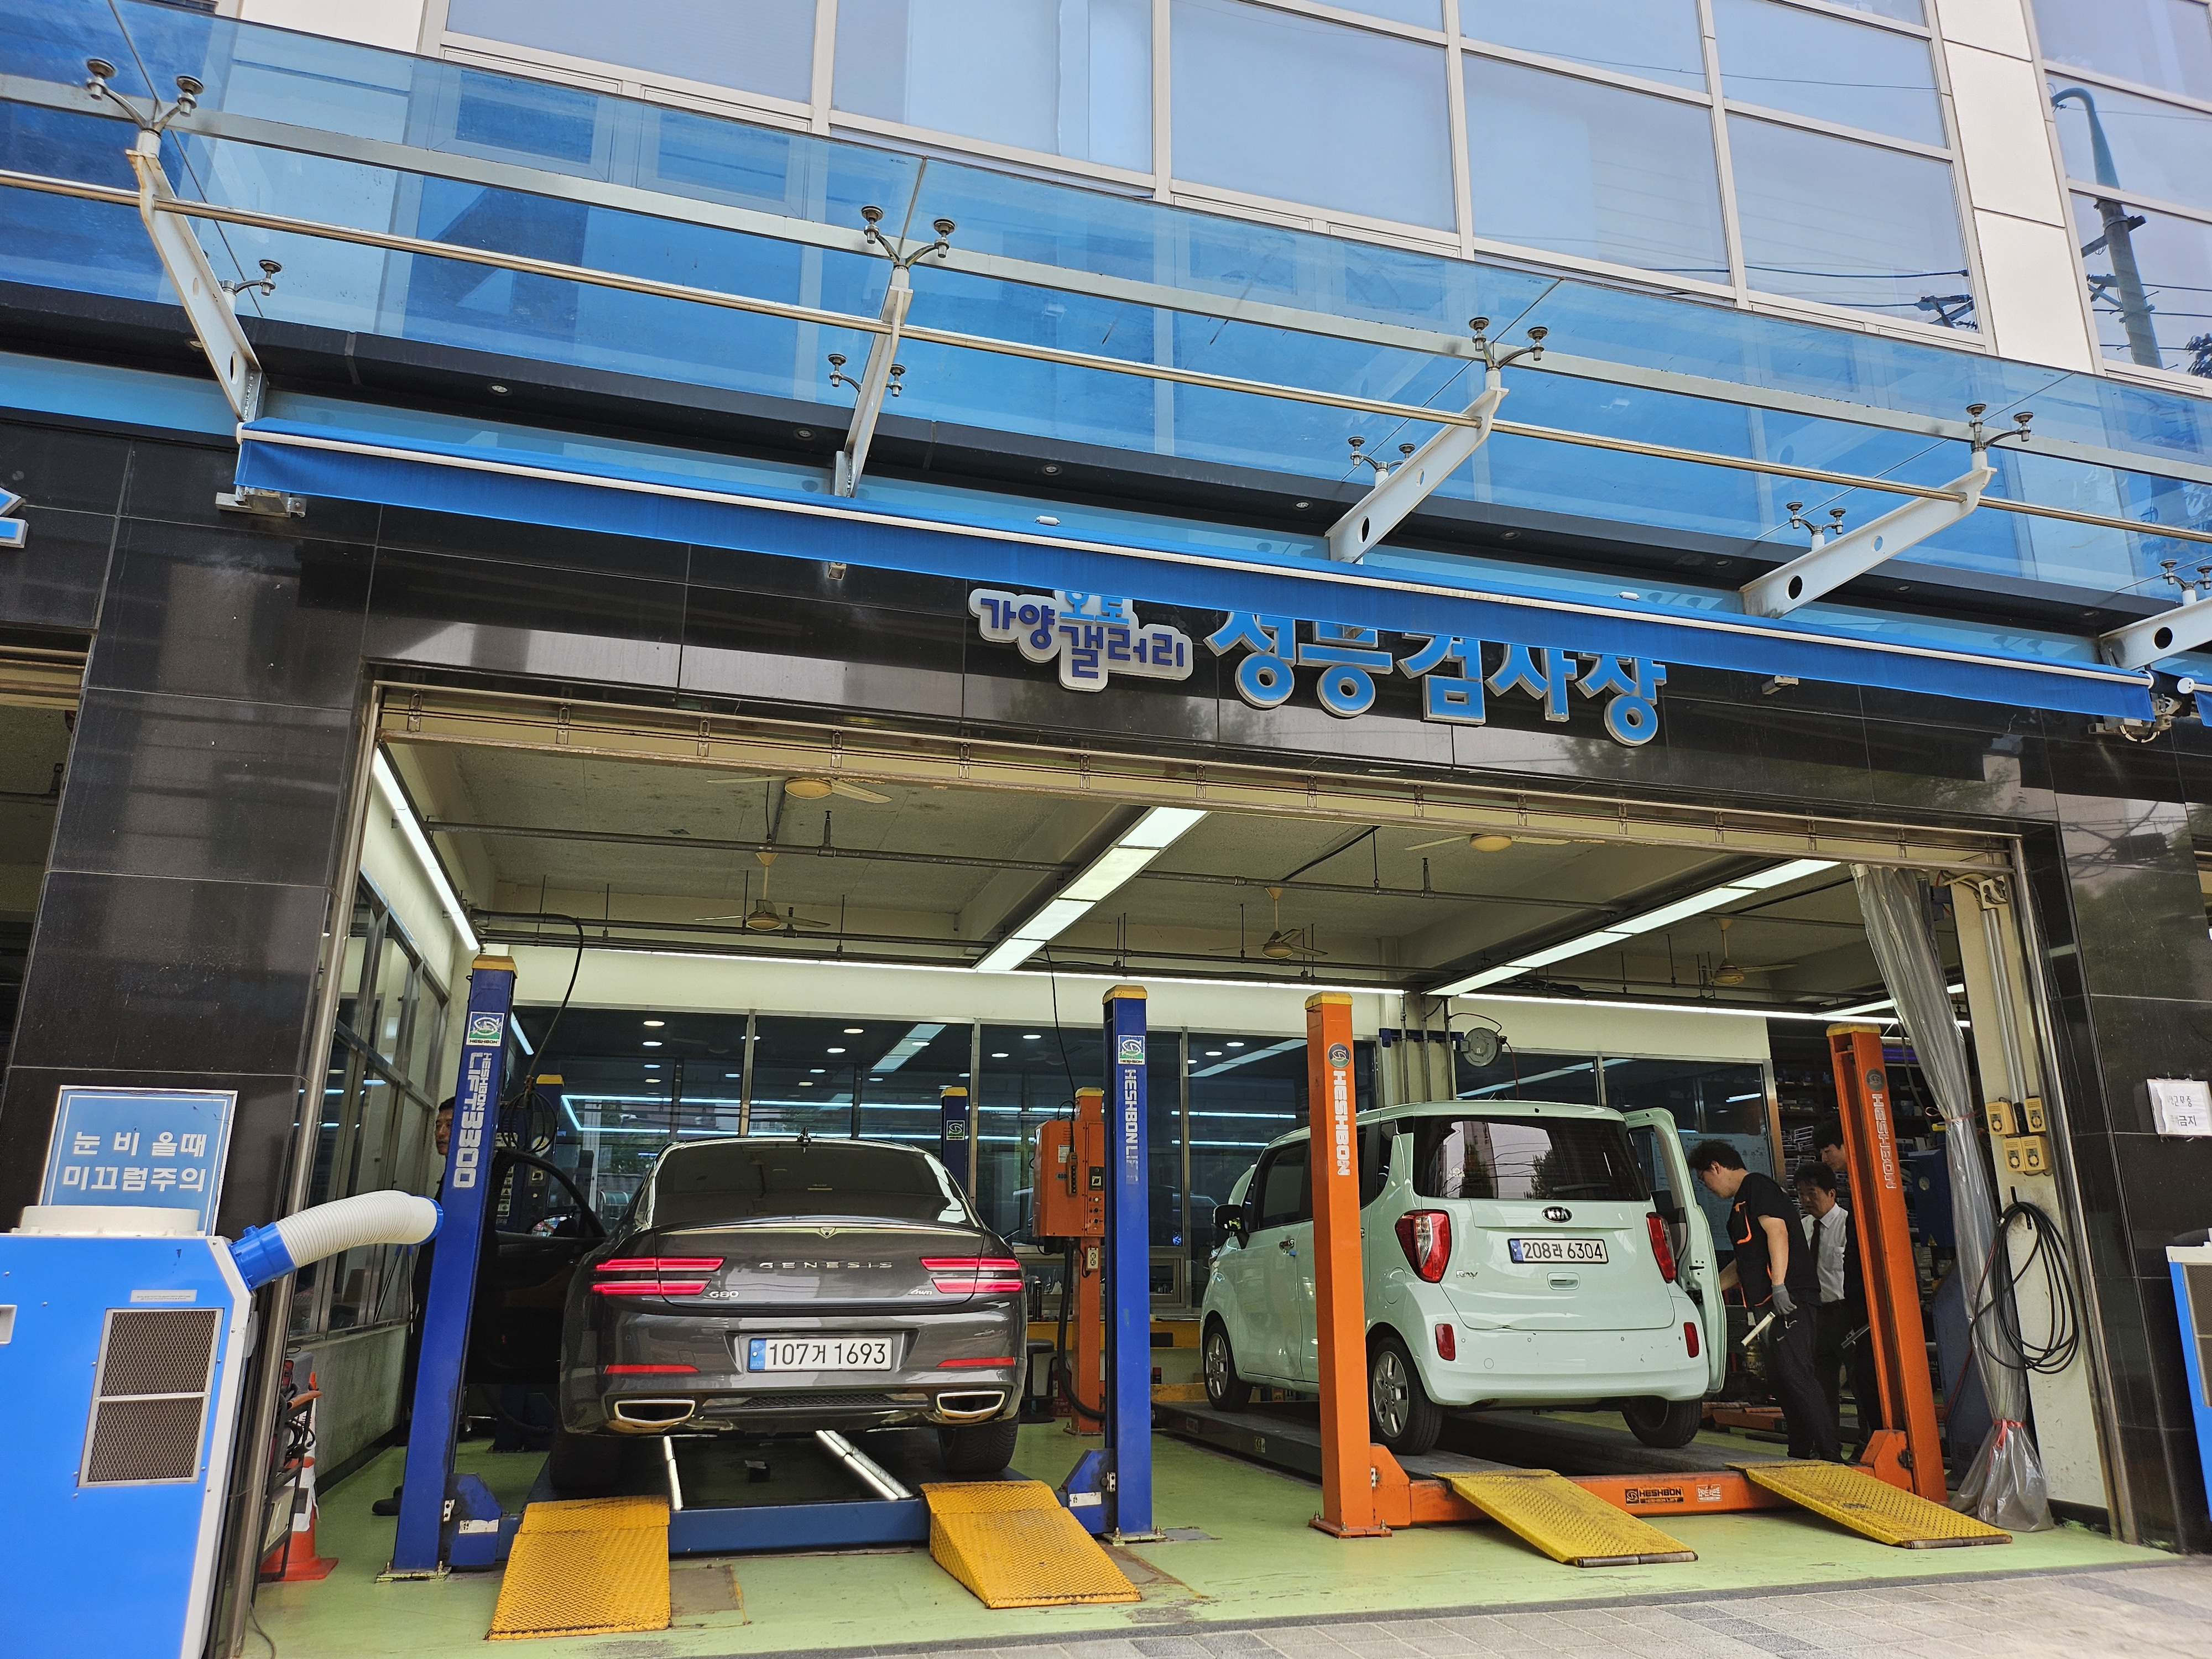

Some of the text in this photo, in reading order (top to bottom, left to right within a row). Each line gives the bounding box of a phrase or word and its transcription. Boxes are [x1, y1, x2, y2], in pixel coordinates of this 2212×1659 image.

[980, 597, 1055, 650] 가양
[1059, 625, 1184, 679] 갤러리
[476, 1052, 492, 1111] HESHBON
[1125, 1069, 1139, 1143] HESHBON
[1333, 1071, 1350, 1176] HESHBON
[74, 1131, 207, 1157] 눈 비 올때
[1872, 1094, 1896, 1188] HESHBON
[62, 1166, 206, 1192] 미끄럼주의
[1548, 1208, 1569, 1219] KIA
[1522, 1242, 1603, 1259] 208라 6304
[709, 1290, 740, 1298] G80
[769, 1342, 885, 1366] 107거 1693
[1639, 1488, 1682, 1497] HESHBON
